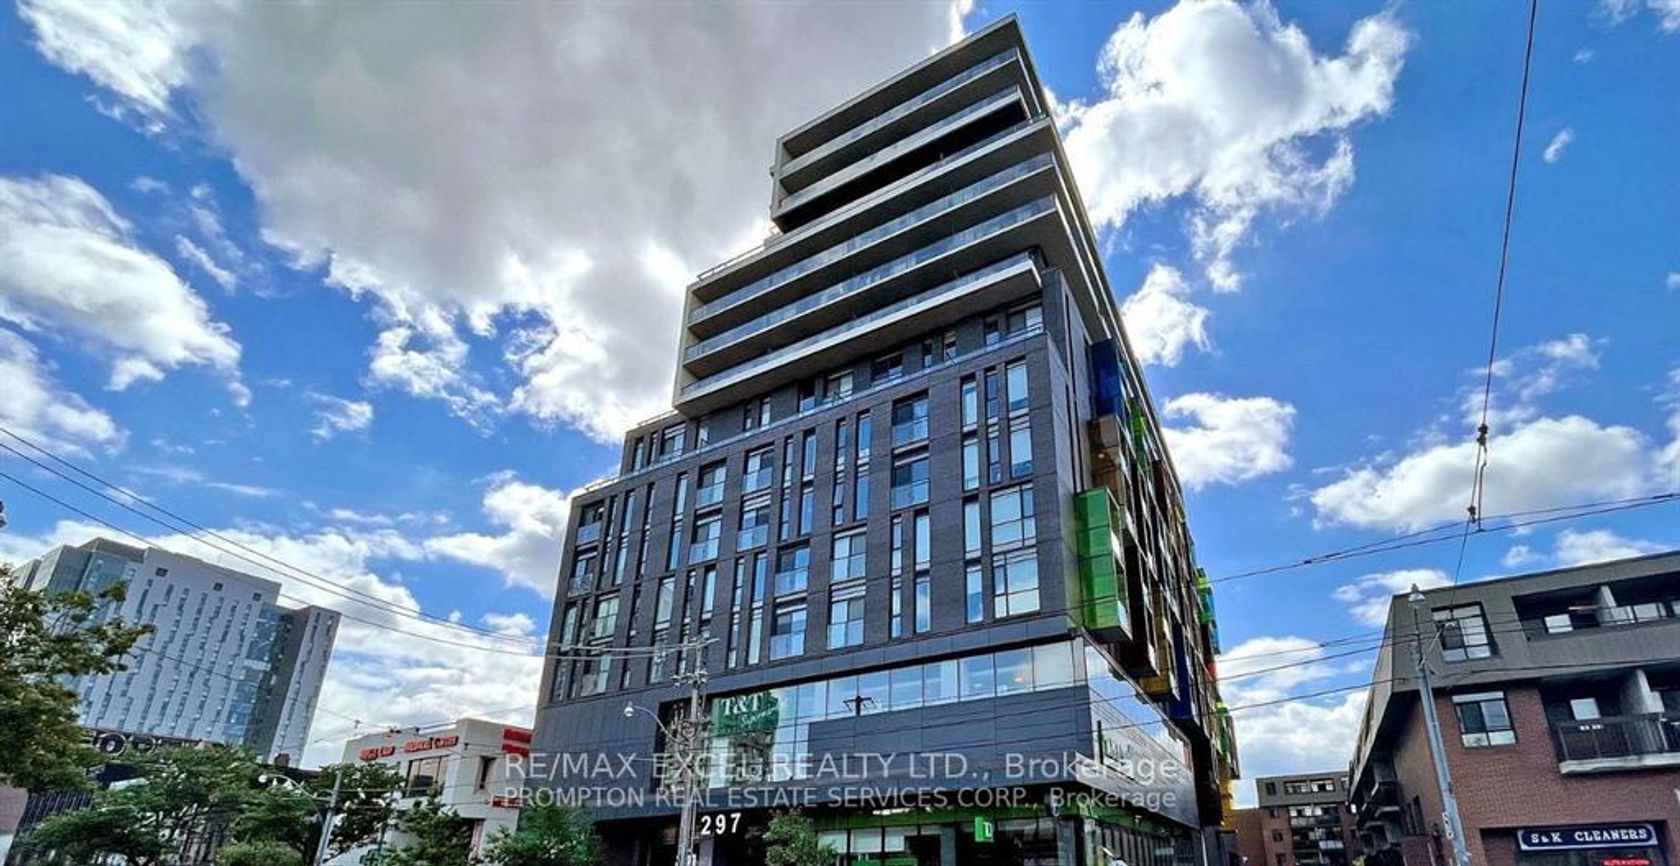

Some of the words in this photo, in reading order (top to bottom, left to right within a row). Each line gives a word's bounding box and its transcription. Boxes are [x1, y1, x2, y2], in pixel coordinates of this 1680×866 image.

[720, 693, 764, 716] T&T
[700, 813, 741, 835] 297
[1530, 831, 1563, 844] S&K
[1574, 828, 1648, 842] CLEANERS
